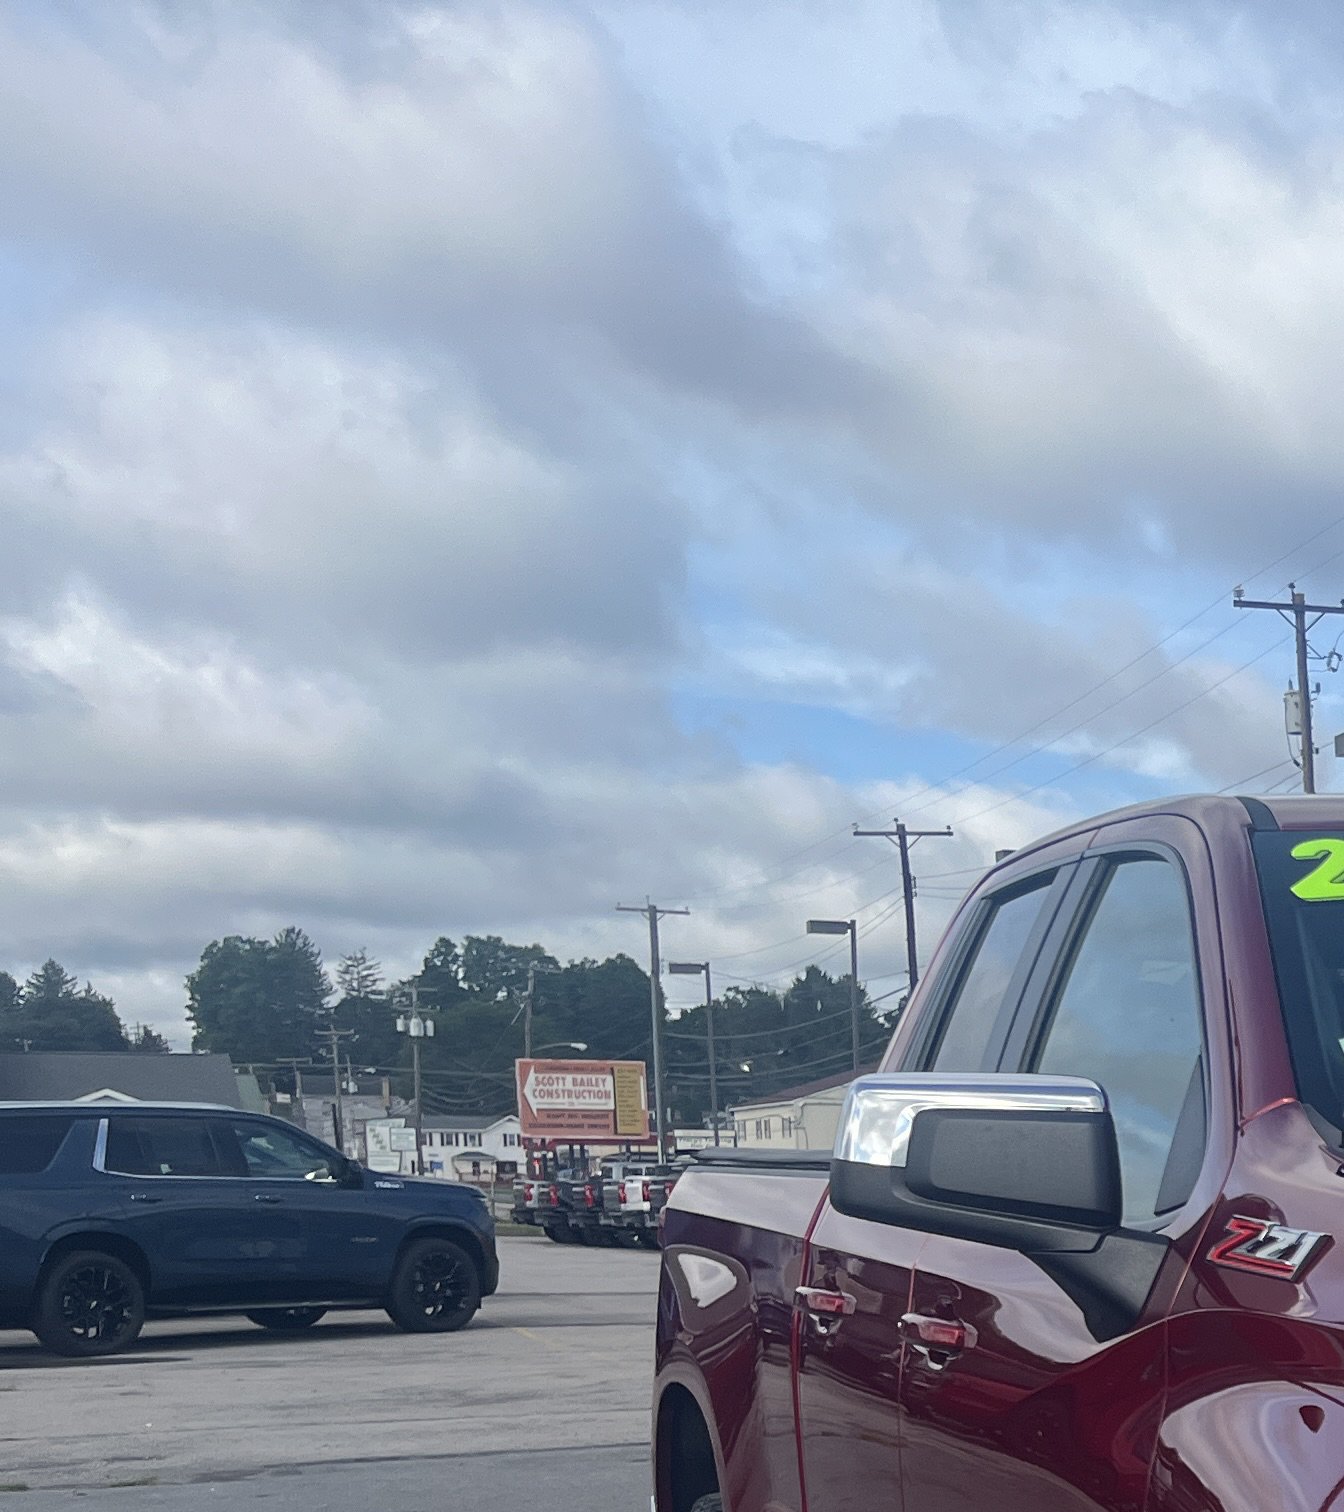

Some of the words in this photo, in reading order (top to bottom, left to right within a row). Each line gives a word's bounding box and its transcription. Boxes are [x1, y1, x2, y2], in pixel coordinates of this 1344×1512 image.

[534, 1076, 567, 1087] SCOTT
[572, 1076, 607, 1088] BAILEY
[532, 1088, 611, 1100] CONSTRUCTION
[1206, 1214, 1335, 1284] Z71
